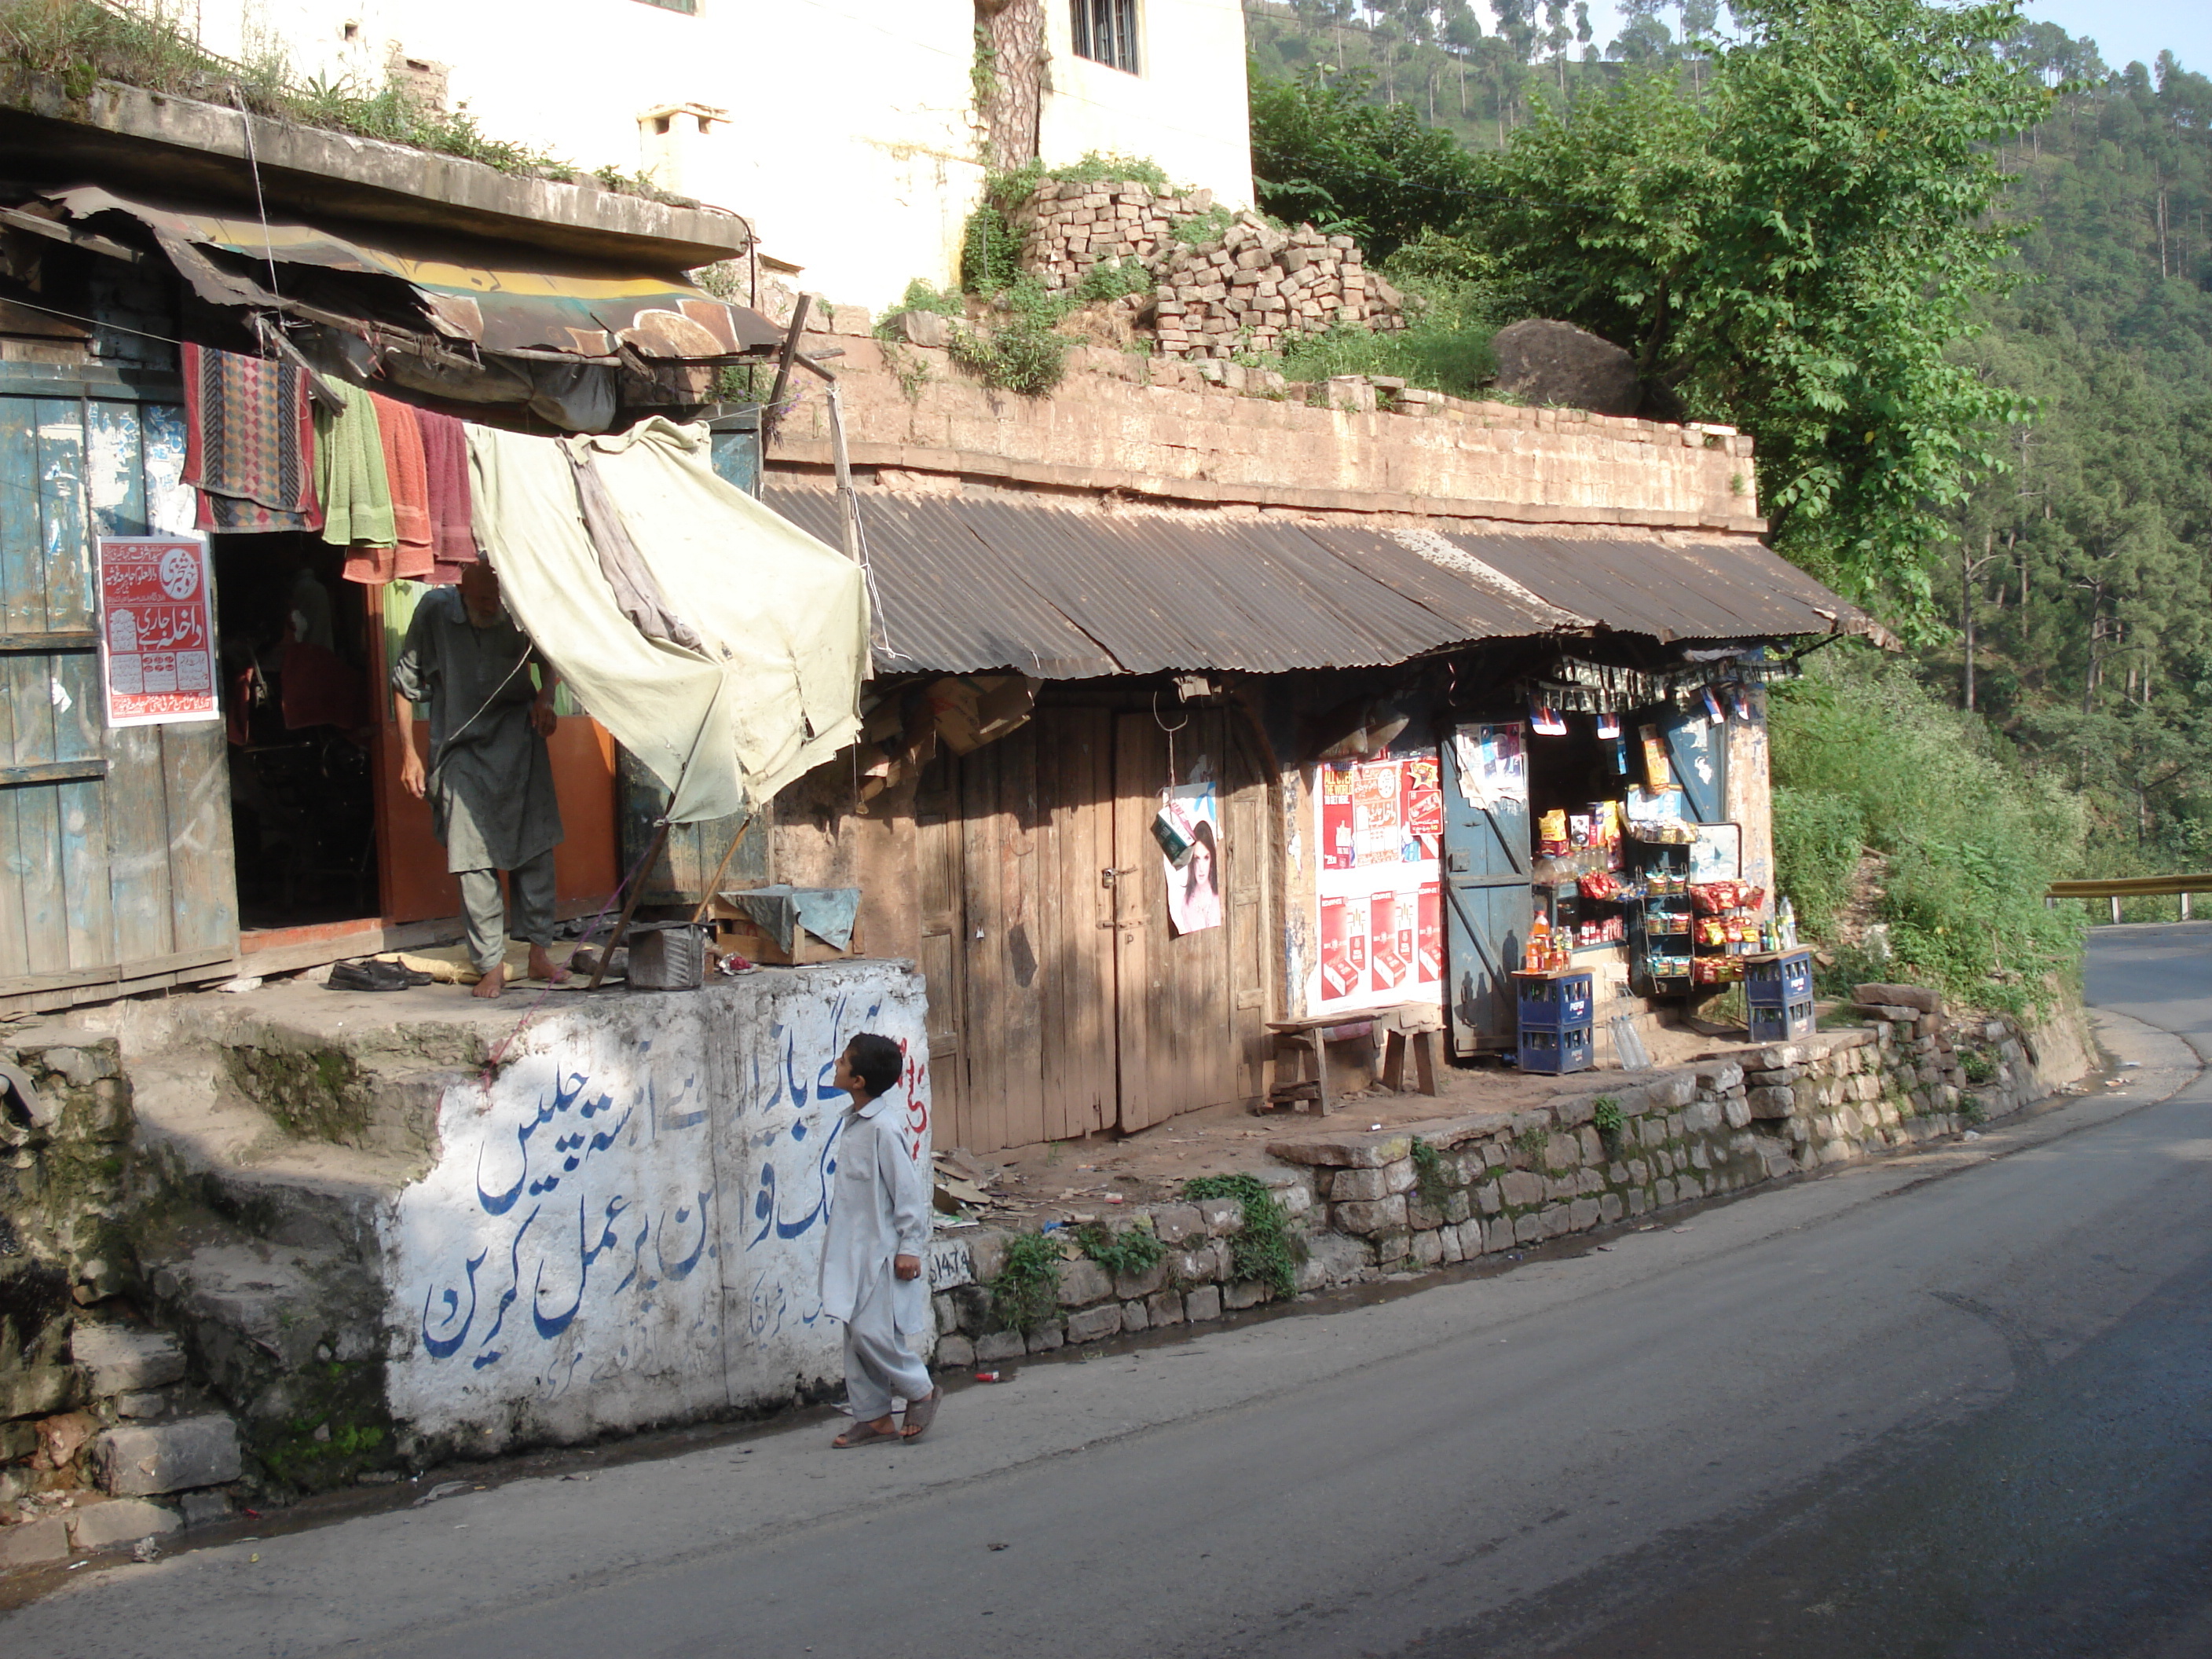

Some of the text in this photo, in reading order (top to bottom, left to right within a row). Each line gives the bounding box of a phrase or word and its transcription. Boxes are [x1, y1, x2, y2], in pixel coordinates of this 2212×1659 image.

[136, 607, 170, 633] جاری
[1324, 771, 1335, 784] ALL
[1324, 785, 1334, 795] THE
[476, 1061, 590, 1217] چلیں
[422, 1203, 541, 1371] کریں
[533, 1194, 632, 1341] عمل
